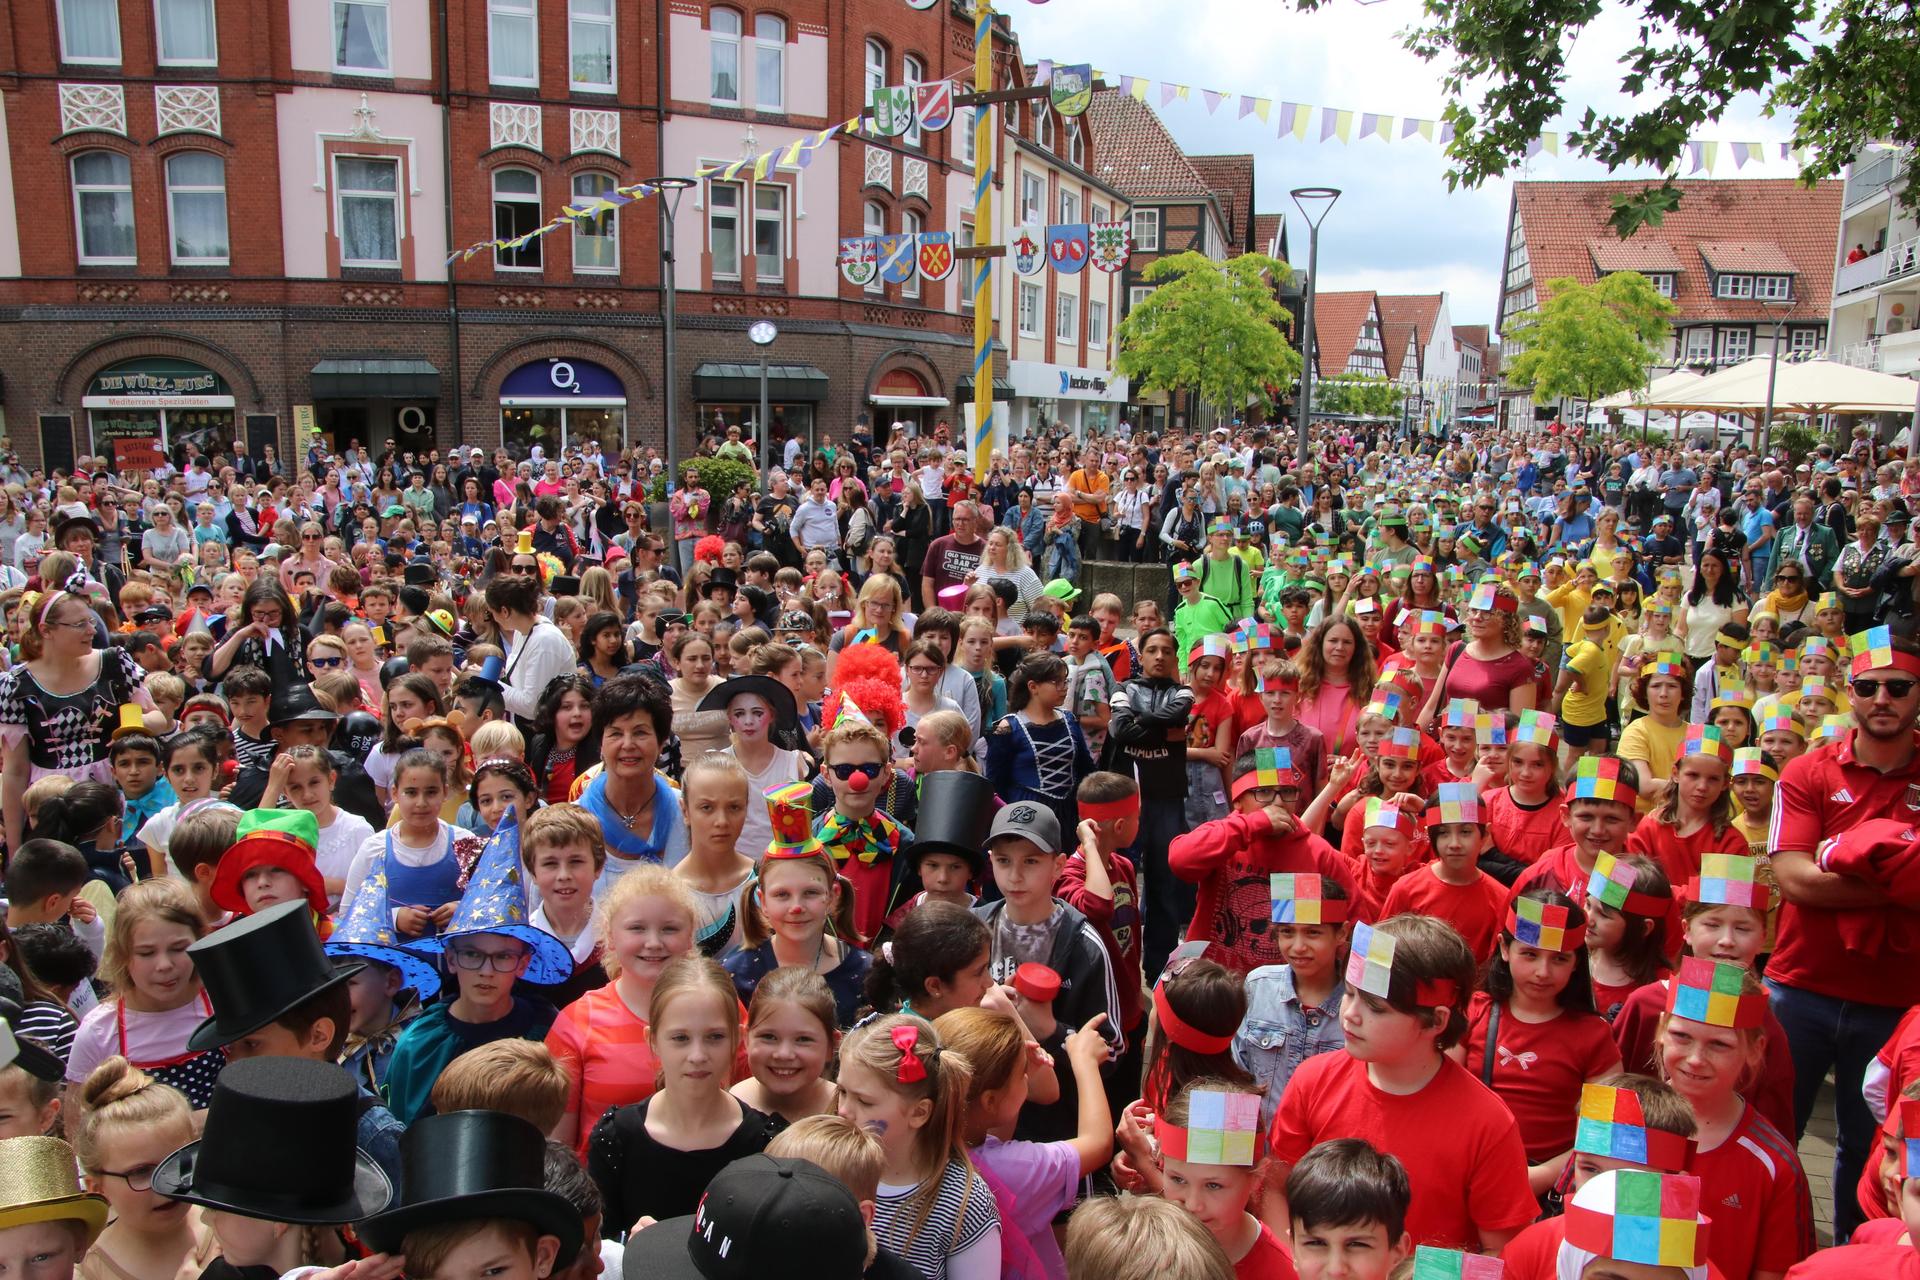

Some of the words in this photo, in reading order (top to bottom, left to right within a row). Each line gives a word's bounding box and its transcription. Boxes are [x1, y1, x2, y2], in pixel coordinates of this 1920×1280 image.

[100, 376, 123, 390] DIE
[108, 398, 156, 406] Mediterrane
[159, 398, 209, 408] Spezialitäten
[953, 558, 970, 567] BAR
[351, 735, 362, 749] KG
